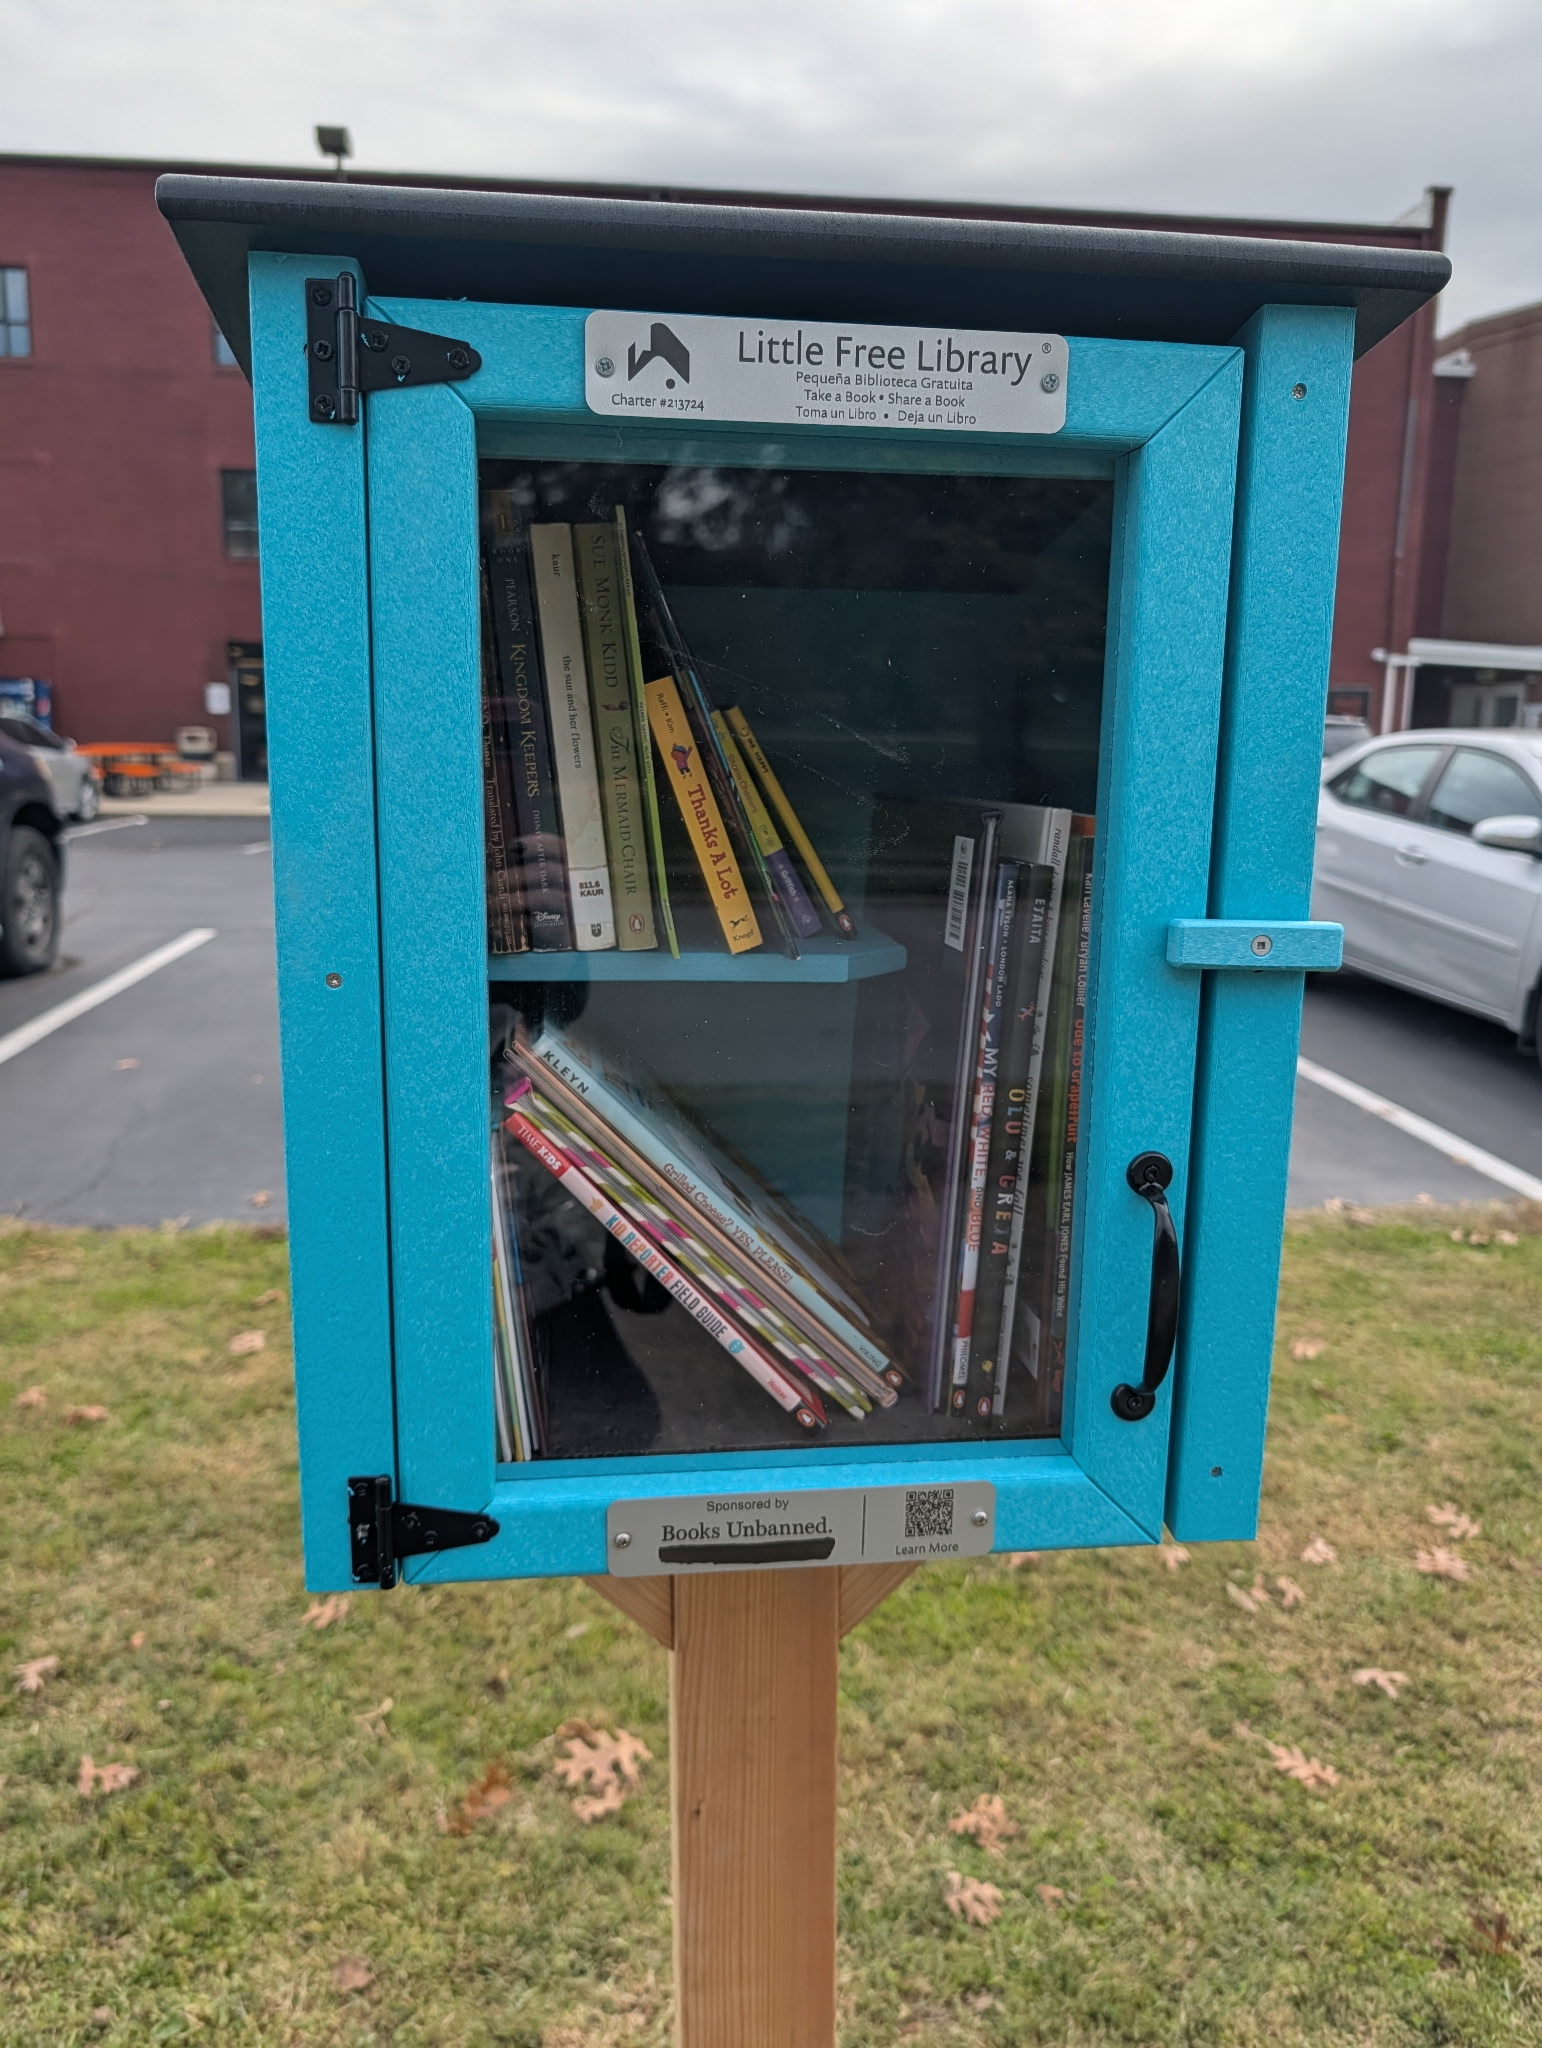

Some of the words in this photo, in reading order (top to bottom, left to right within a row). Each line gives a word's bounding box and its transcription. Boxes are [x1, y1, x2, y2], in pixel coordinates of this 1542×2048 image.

[737, 329, 823, 368] Little
[835, 335, 907, 370] Free
[918, 340, 1033, 386] Library
[796, 371, 852, 388] Pequeña
[855, 374, 918, 389] Biblioteca
[921, 377, 973, 392] Gratuita
[611, 393, 657, 408] Charter
[659, 397, 705, 413] #213724
[803, 389, 833, 403] Take
[835, 393, 842, 403] a
[845, 391, 877, 405] Book
[887, 393, 920, 406] Share
[923, 397, 931, 407] a
[934, 394, 966, 408] Book
[795, 406, 829, 419] Toma
[832, 410, 845, 420] un
[848, 408, 877, 421] Libro
[897, 411, 926, 425] Deja
[929, 415, 943, 424] un
[946, 412, 977, 426] Libro
[551, 554, 561, 577] kaur
[590, 535, 607, 569] SUE
[505, 579, 521, 632] PEARSON
[594, 577, 613, 635] MONK
[562, 656, 573, 672] the
[602, 642, 619, 688] KIDD
[564, 674, 574, 691] sun
[567, 693, 577, 712] and
[656, 693, 669, 712] Raffi
[665, 718, 676, 734] Kim
[568, 714, 579, 730] her
[571, 733, 584, 769] flowers
[485, 777, 501, 829] Translated
[612, 766, 631, 841] MERMAID
[490, 831, 503, 841] by
[687, 784, 718, 849] Thanks
[708, 852, 725, 866] A
[718, 868, 739, 900] Lot
[1050, 828, 1062, 867] randall
[492, 845, 504, 868] John
[621, 845, 637, 896] CHAIR
[496, 870, 508, 900] Ciardi
[579, 889, 605, 898] KAUR
[532, 911, 561, 921] Disney
[1002, 909, 1012, 938] TYSON
[732, 929, 754, 942] Knopf
[998, 946, 1007, 982] LONDON
[995, 984, 1004, 1007] LADD
[542, 1050, 590, 1095] KLEYN
[983, 1048, 999, 1078] MY
[1064, 1152, 1074, 1171] How
[663, 1163, 696, 1194] Grilled
[694, 1191, 734, 1228] Cheese?
[1063, 1172, 1073, 1200] JAMES
[1061, 1201, 1071, 1224] EARL
[968, 1213, 983, 1252] BLUE
[1059, 1225, 1069, 1253] JONES
[604, 1213, 628, 1238] KID
[622, 1230, 674, 1286] REPORTER
[670, 1279, 699, 1313] FIELD
[695, 1308, 729, 1340] GUIDE
[1057, 1254, 1068, 1279] Found
[1057, 1280, 1065, 1294] His
[1055, 1295, 1065, 1318] Voice
[958, 1340, 969, 1381] PHILOMEL
[706, 1498, 770, 1514] Sponsored
[771, 1497, 790, 1512] by
[661, 1522, 721, 1542] Books
[726, 1516, 834, 1539] Unbanned.
[895, 1543, 925, 1556] Learn
[928, 1541, 959, 1554] More
